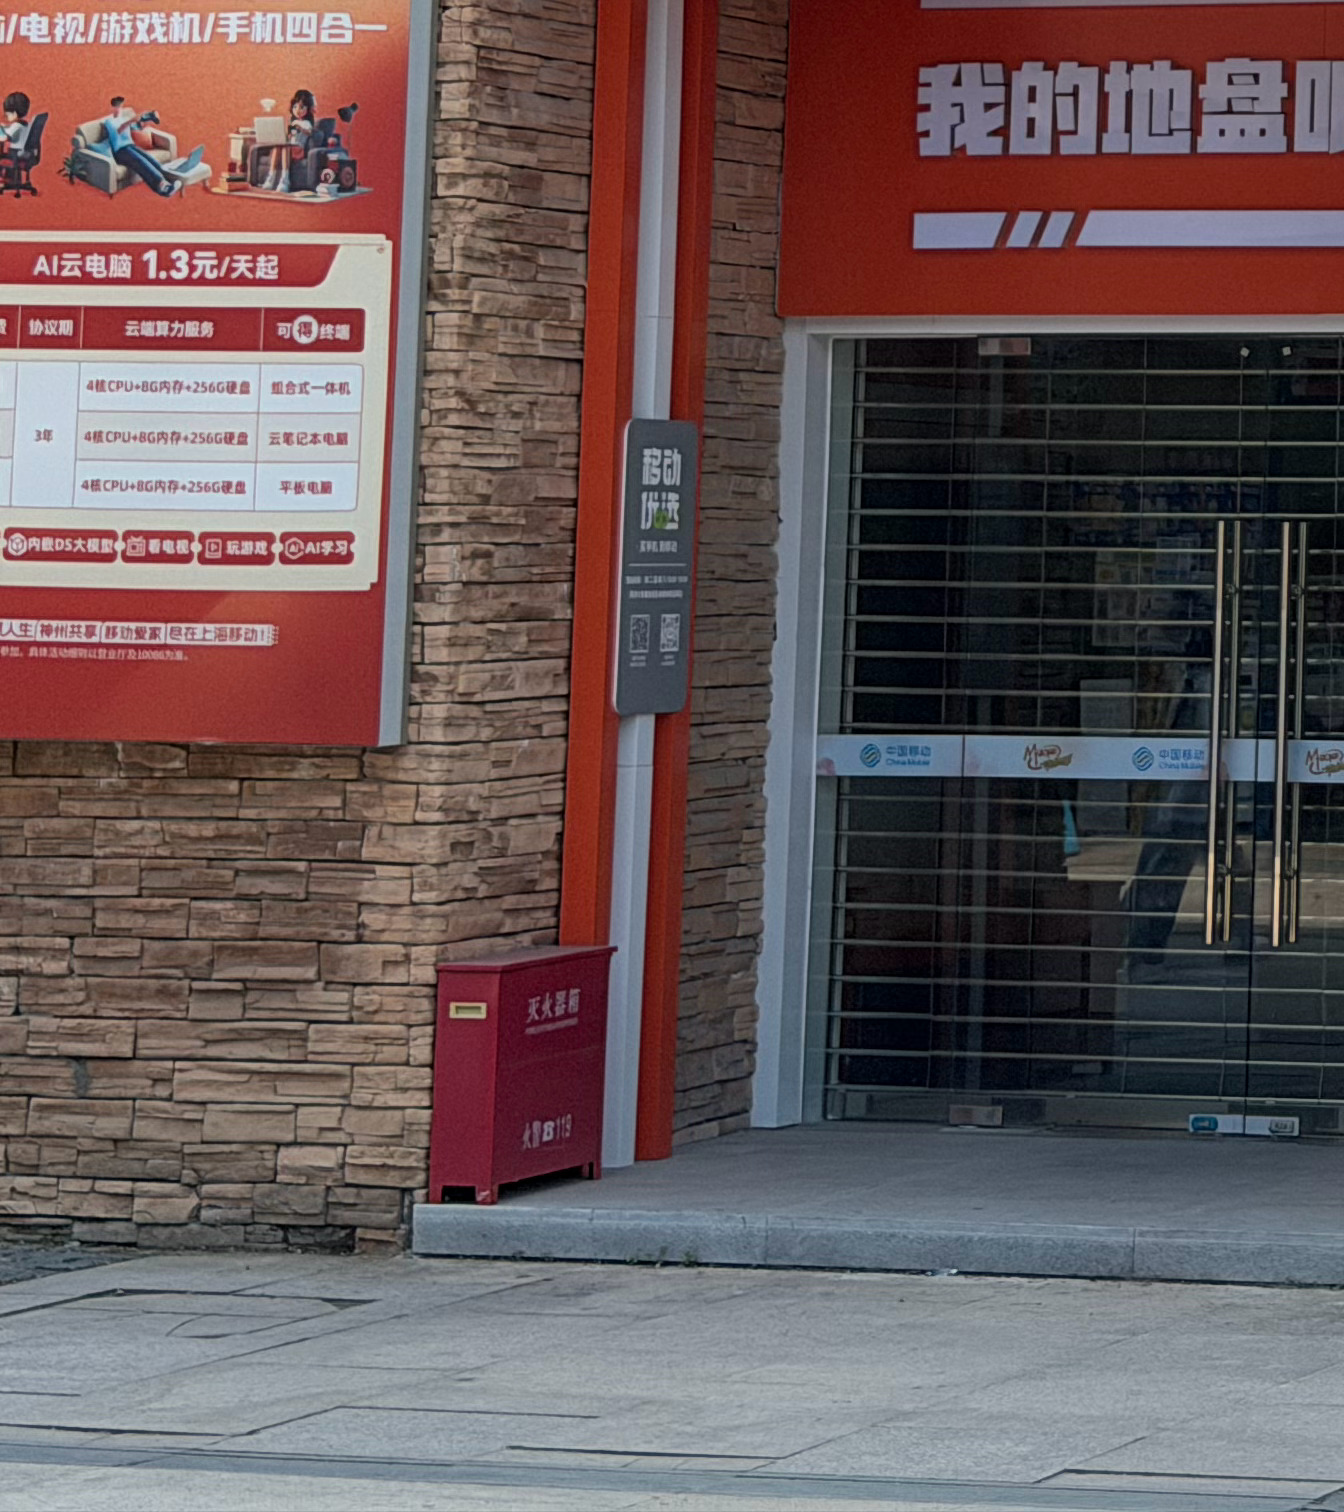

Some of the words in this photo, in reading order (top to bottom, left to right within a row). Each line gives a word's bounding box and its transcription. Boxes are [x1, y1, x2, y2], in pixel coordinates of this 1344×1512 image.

[0, 11, 388, 45] /电视/游戏机/手机四合一
[33, 253, 132, 279] AI云电脑
[141, 249, 279, 281] 1.3元/天起
[29, 318, 74, 336] 协议期
[124, 320, 215, 338] 云端算力服务
[641, 447, 682, 487] 移动
[280, 480, 333, 496] 平板电脑
[305, 540, 349, 557] AI学习
[0, 620, 33, 638] 人生
[526, 988, 581, 1024] 灭火器箱
